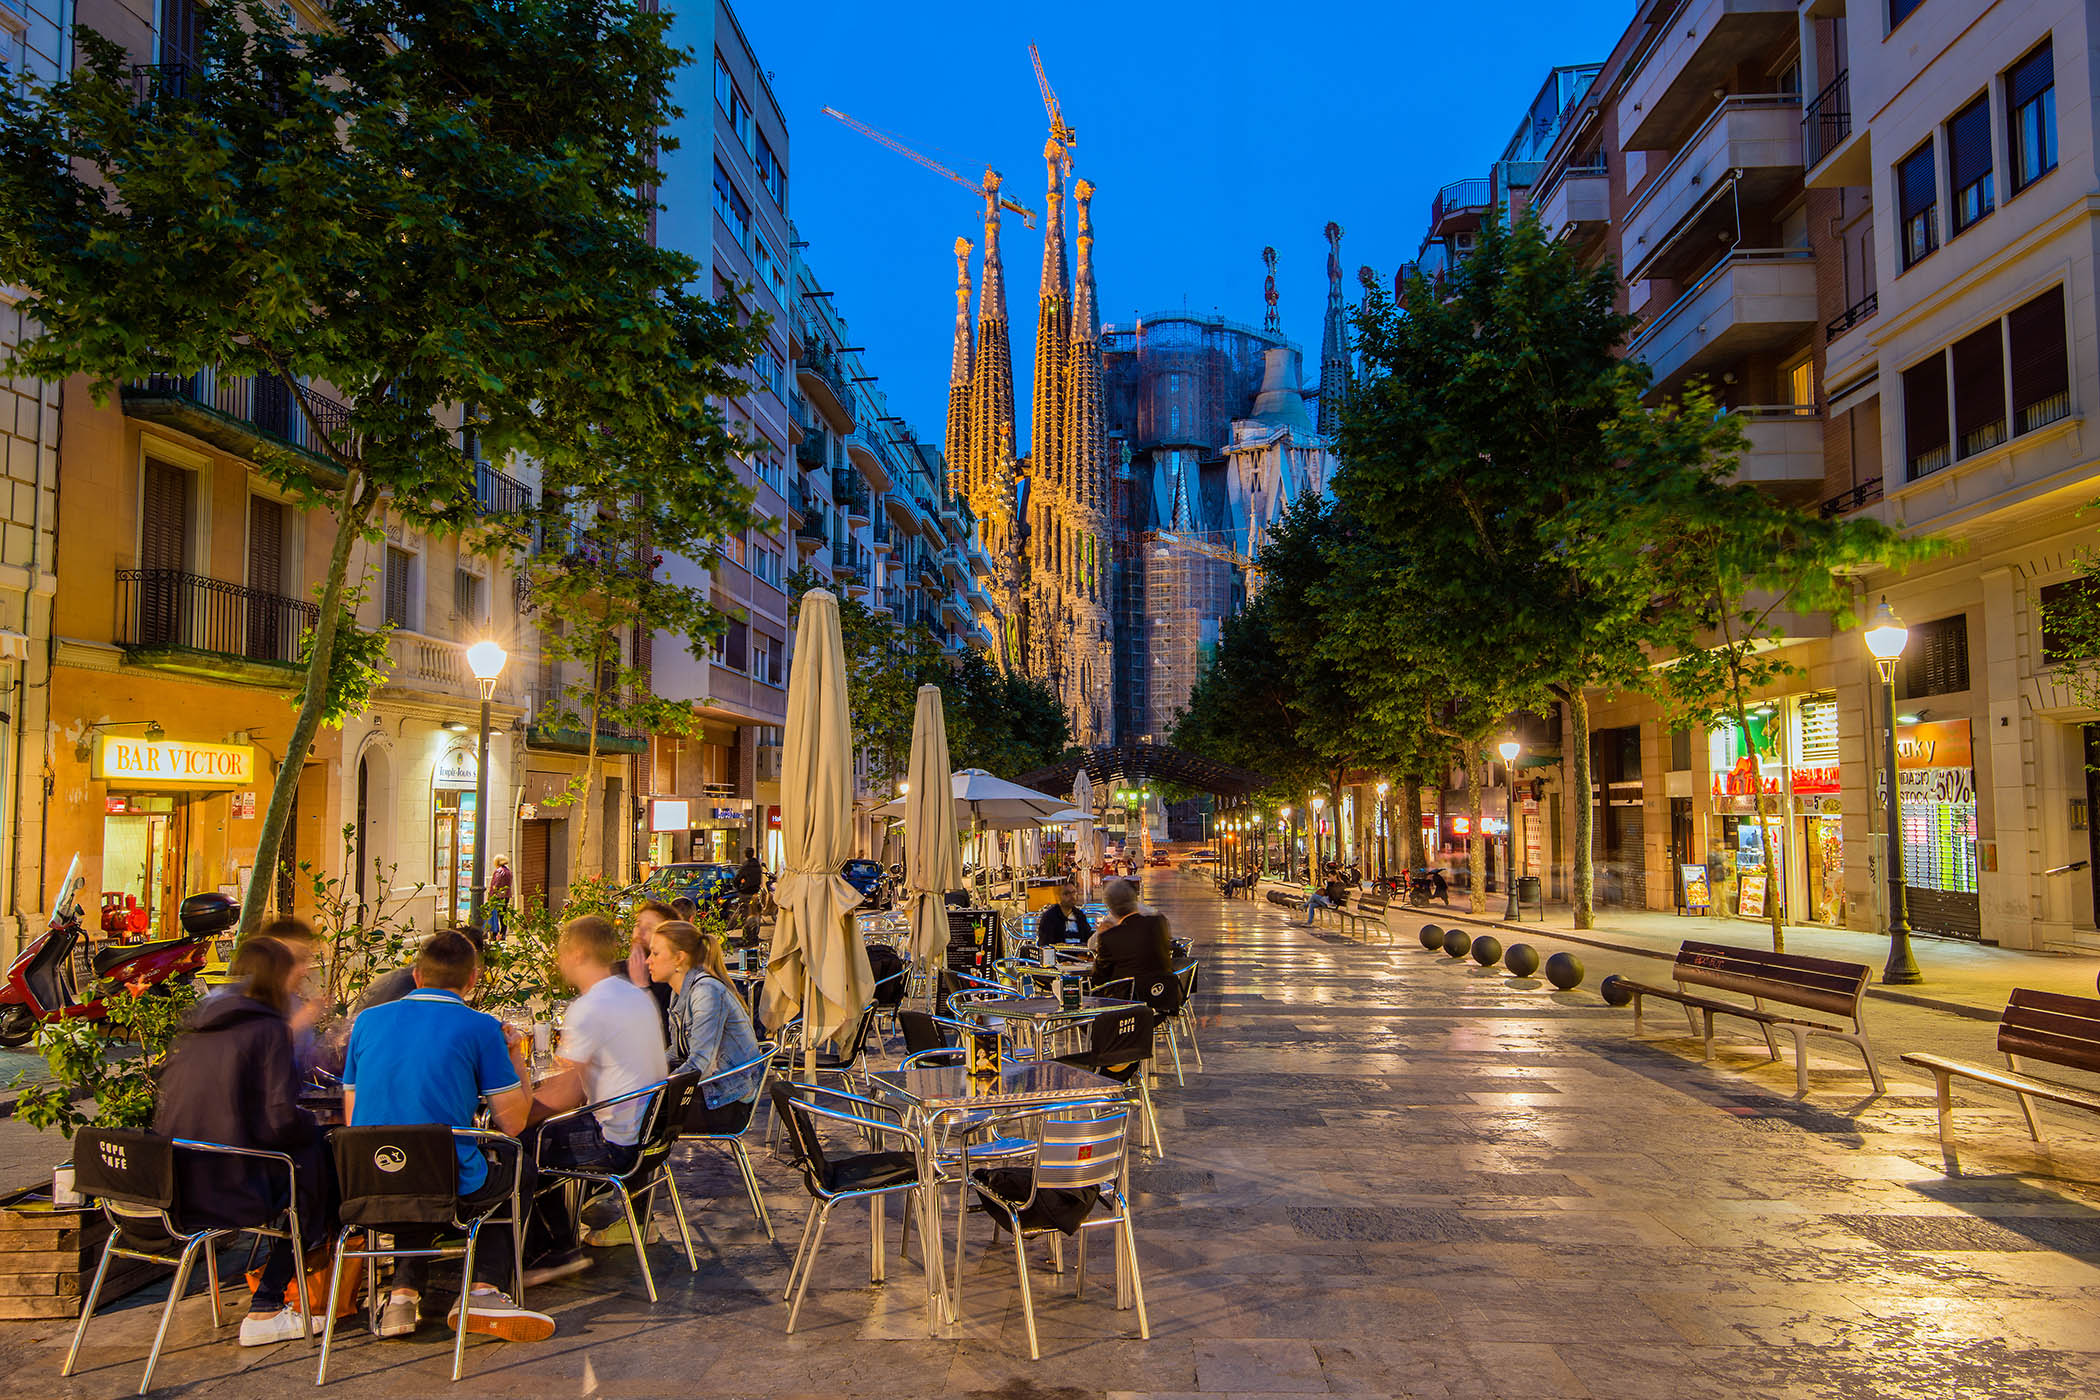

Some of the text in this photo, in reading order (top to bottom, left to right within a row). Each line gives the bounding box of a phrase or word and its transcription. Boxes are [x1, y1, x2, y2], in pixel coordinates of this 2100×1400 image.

[116, 745, 242, 775] BAR VICTOR
[1900, 791, 1929, 805] STOCK
[100, 1140, 125, 1157] COPA
